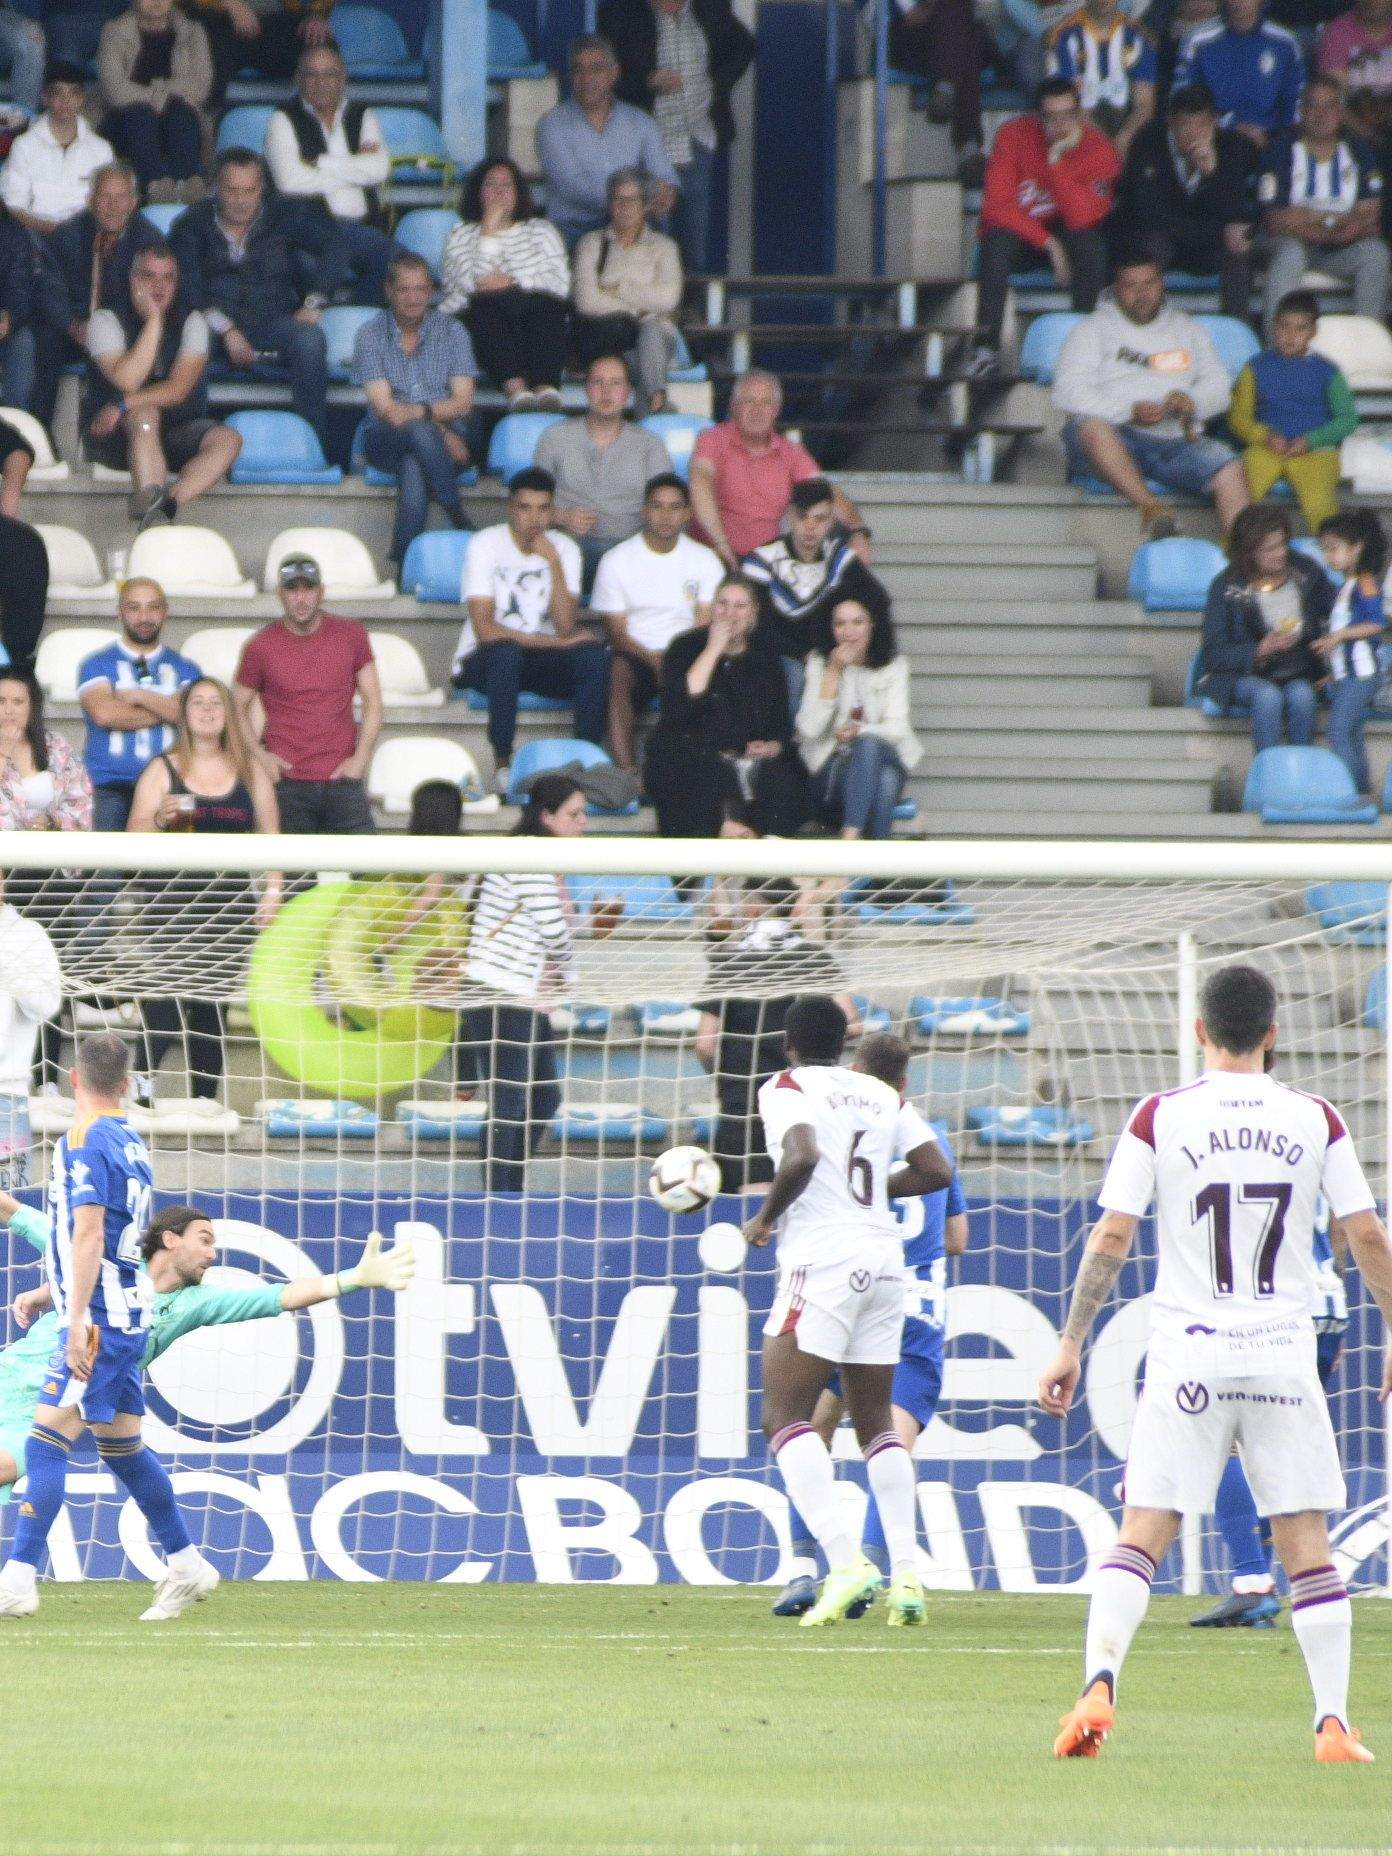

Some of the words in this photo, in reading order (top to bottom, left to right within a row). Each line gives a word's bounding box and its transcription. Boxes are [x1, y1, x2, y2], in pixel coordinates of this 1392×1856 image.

[846, 1129, 874, 1209] 6
[1210, 1127, 1304, 1166] ALONSO
[1190, 1182, 1293, 1300] 17
